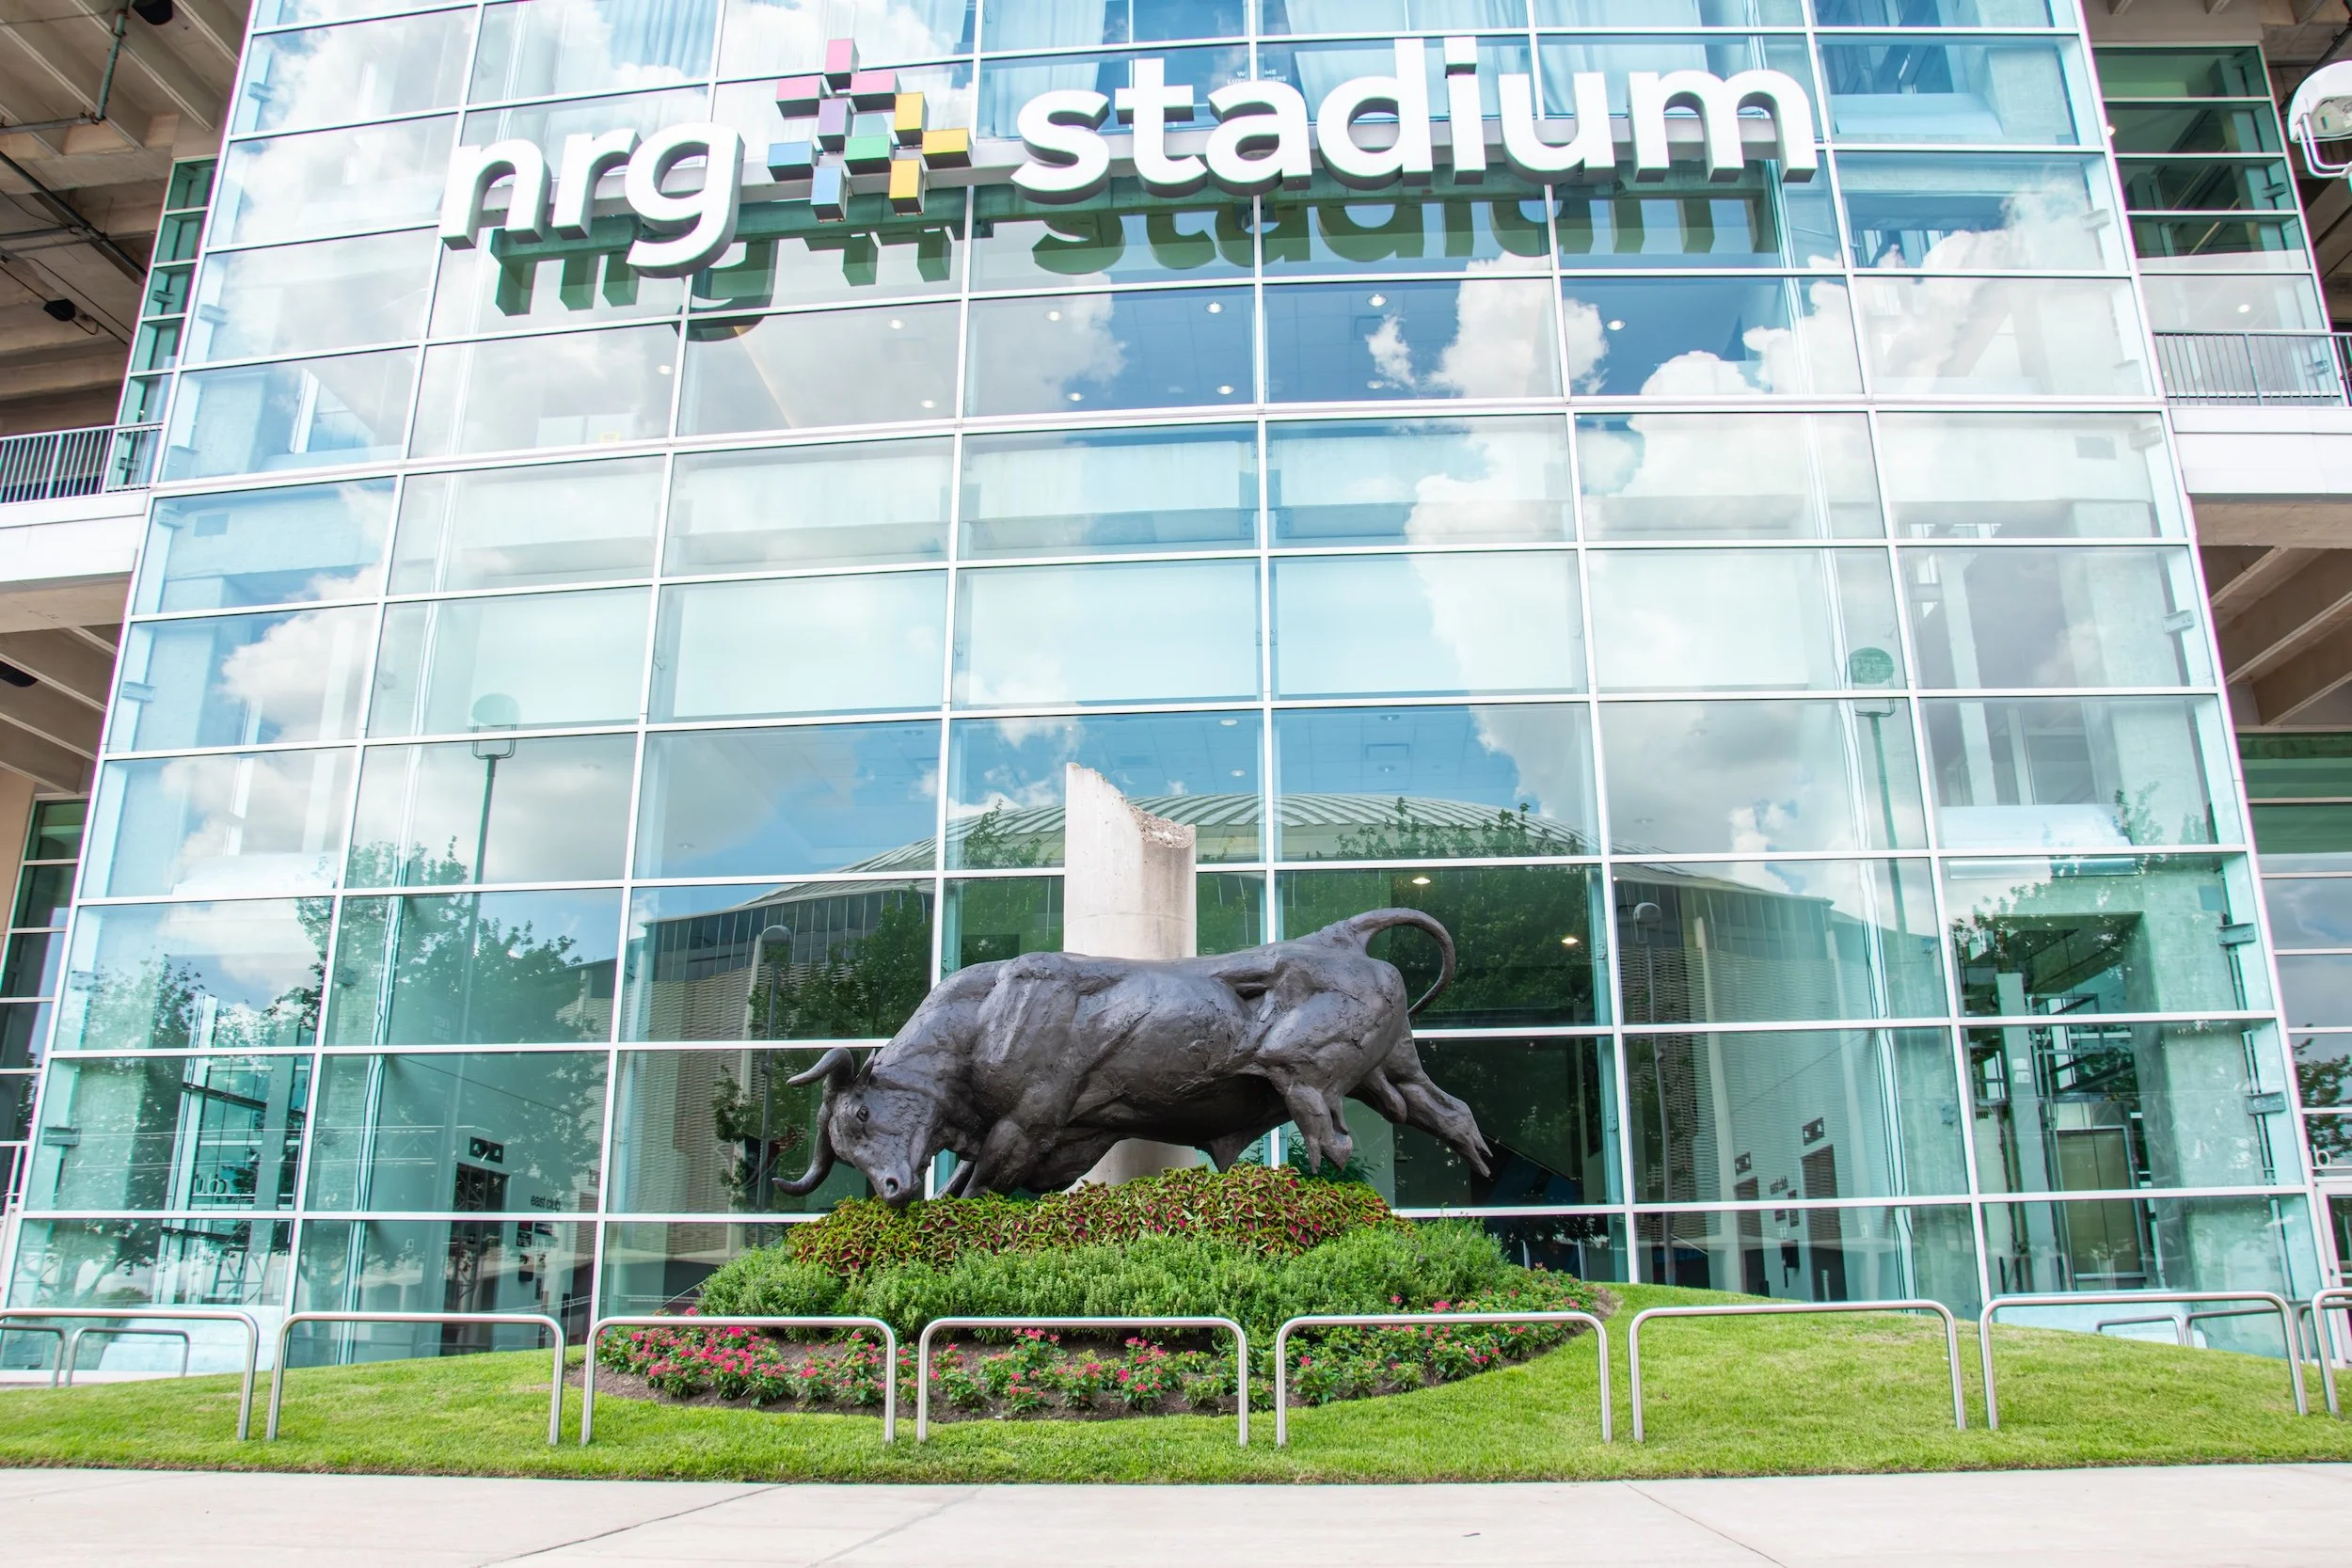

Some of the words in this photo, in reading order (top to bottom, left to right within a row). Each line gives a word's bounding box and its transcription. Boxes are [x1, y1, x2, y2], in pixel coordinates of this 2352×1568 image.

[438, 122, 745, 278] nrg
[1010, 37, 1819, 204] stadium
[531, 1196, 546, 1208] east
[547, 1196, 561, 1212] club
